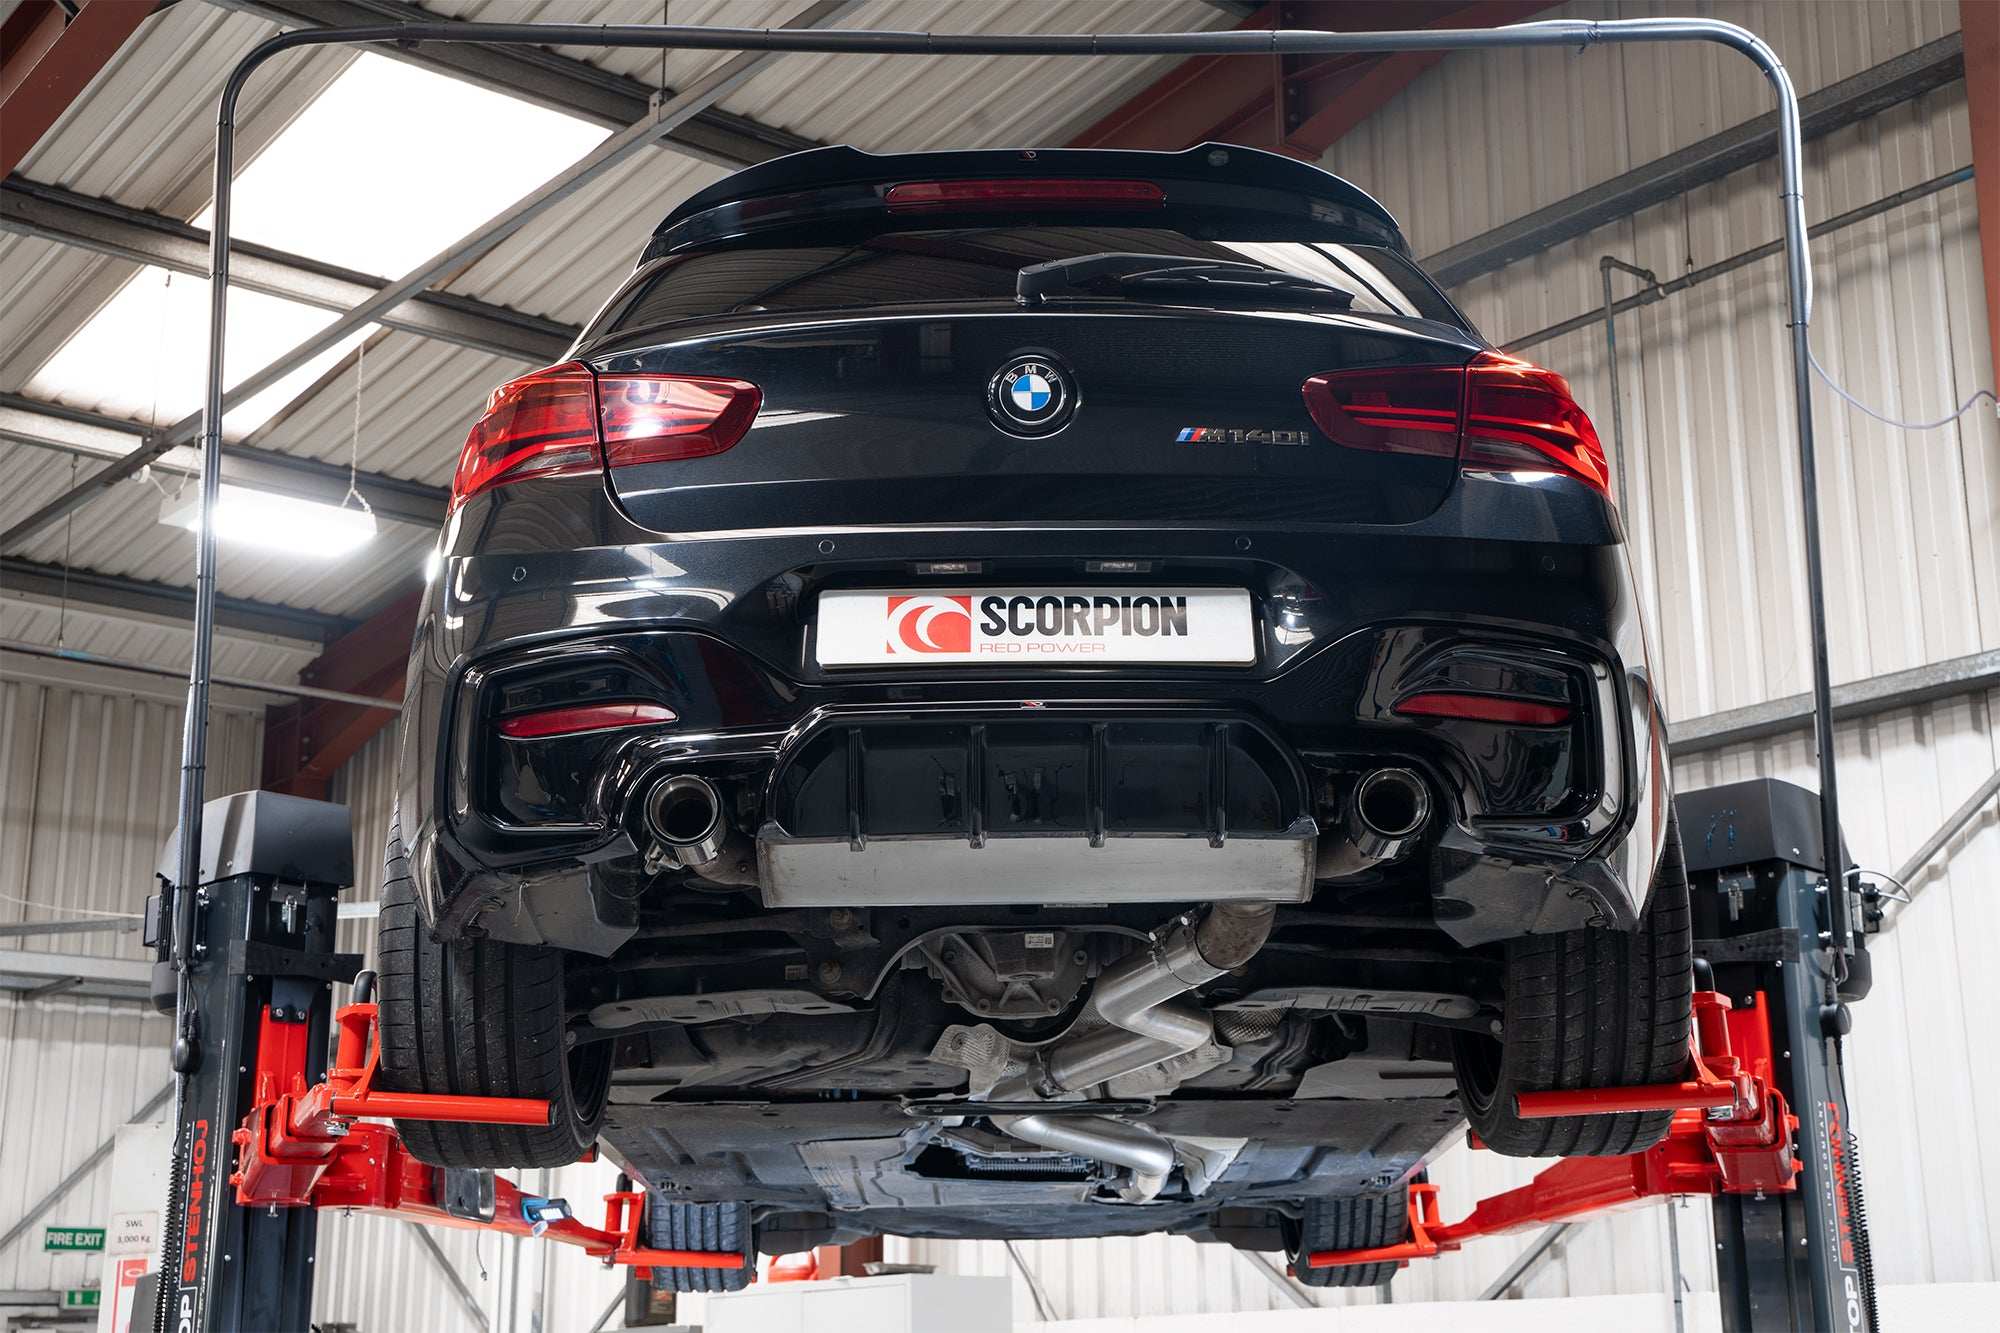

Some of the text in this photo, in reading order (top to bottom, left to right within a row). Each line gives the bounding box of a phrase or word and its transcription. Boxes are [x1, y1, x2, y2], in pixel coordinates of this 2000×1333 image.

[1006, 365, 1057, 383] BMW
[980, 596, 1188, 637] SCORPION
[979, 642, 1106, 653] RED POWER
[174, 1122, 191, 1283] UPLIFTING COMPANY
[46, 1231, 103, 1247] FIRE EXIT
